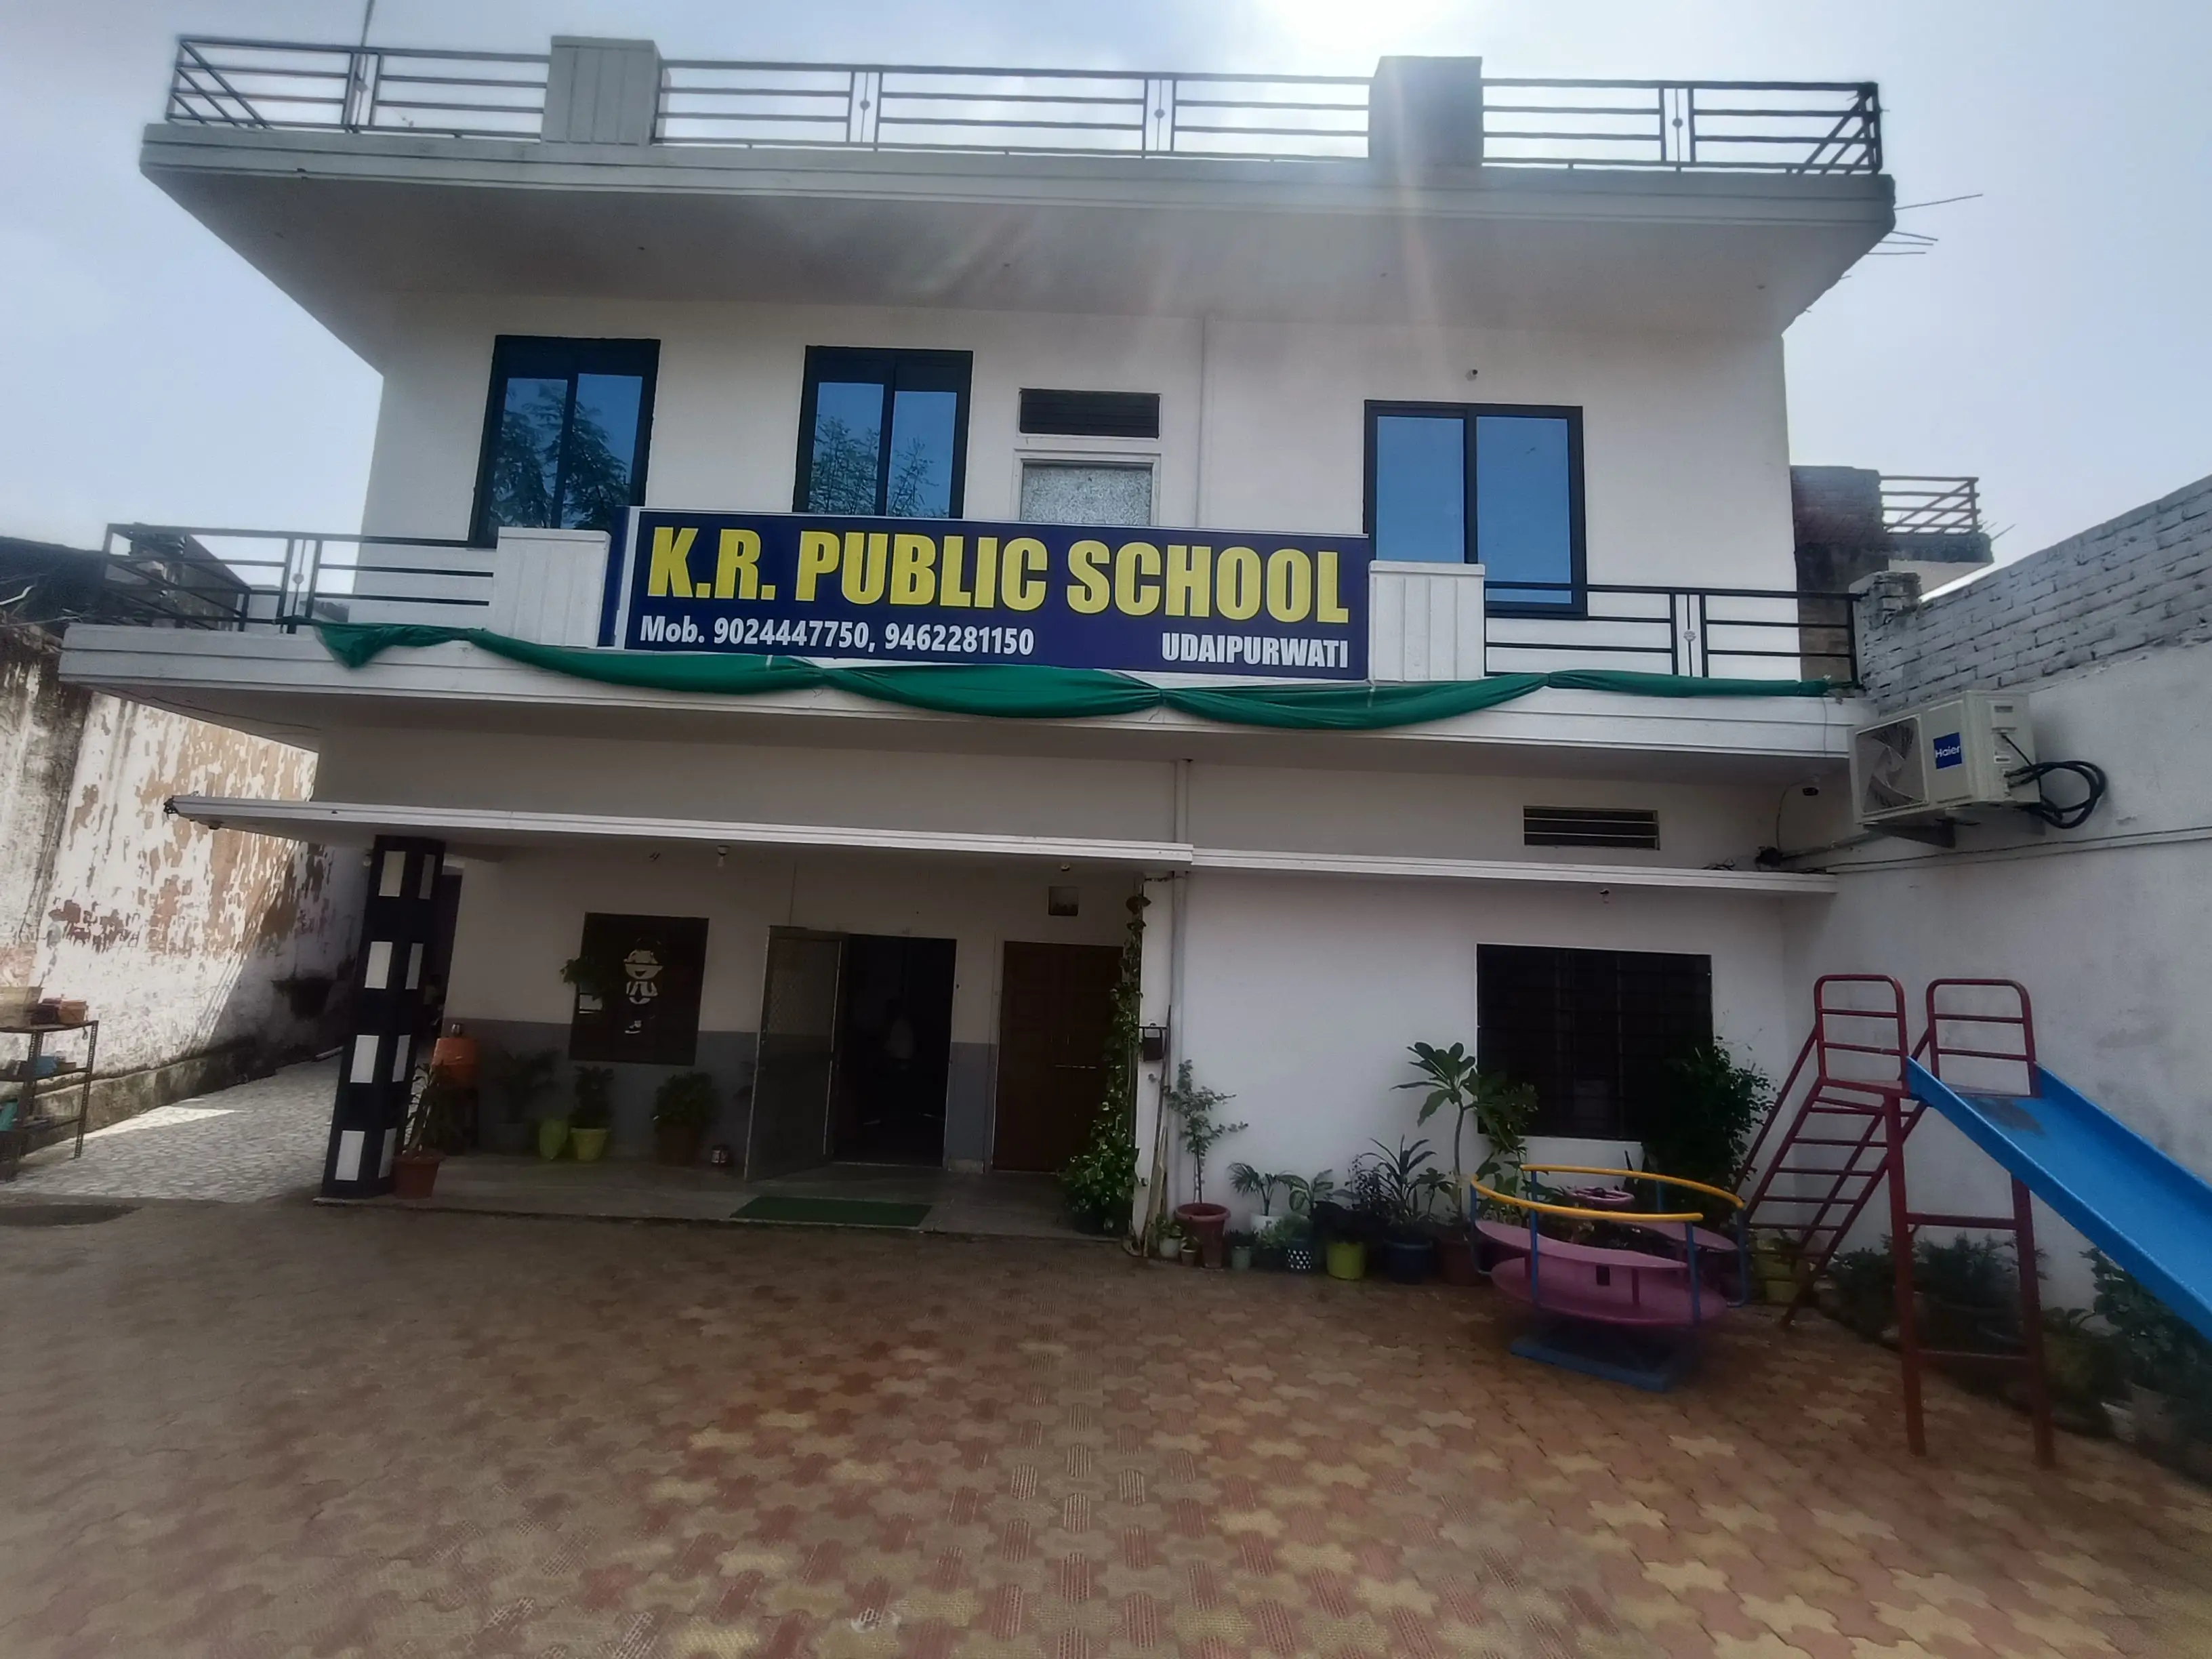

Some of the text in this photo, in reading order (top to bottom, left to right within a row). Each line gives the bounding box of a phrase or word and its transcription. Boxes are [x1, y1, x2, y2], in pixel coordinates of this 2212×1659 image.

[647, 527, 1349, 623] K.R. PUBLIC SCHOOL
[640, 615, 1034, 656] Mob. 9024447750, 9462281150
[1162, 632, 1349, 668] UDAIPURWATI
[1935, 745, 1961, 758] Haier
